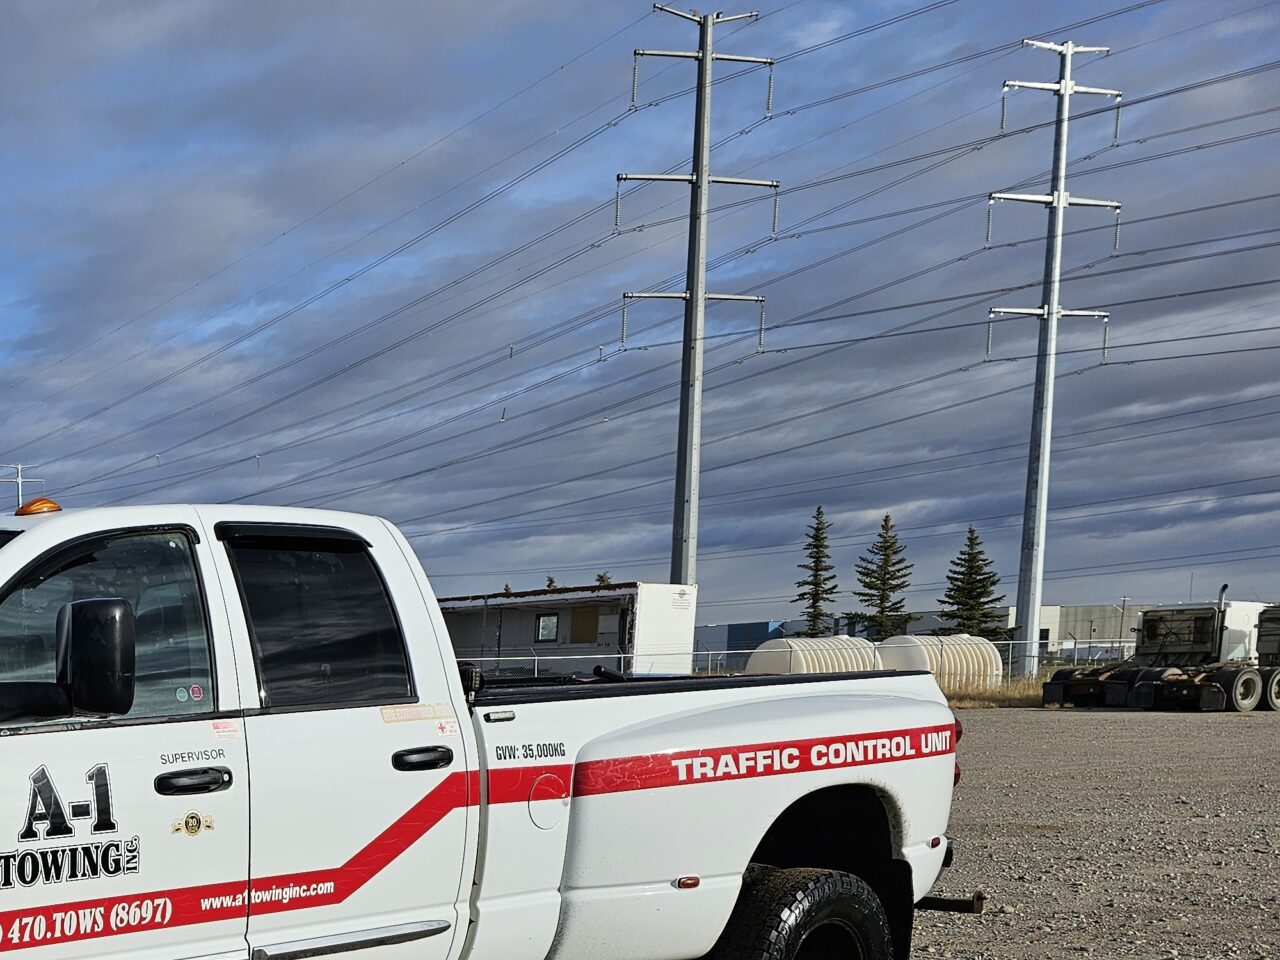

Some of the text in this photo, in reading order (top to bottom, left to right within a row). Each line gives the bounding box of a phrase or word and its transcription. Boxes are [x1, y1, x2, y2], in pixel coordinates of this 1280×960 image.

[160, 748, 226, 765] SUPERVISOR
[495, 742, 566, 761] GVW: 35,000KG
[672, 730, 951, 781] TRAFFIC CONTROL UNIT
[18, 763, 118, 842] A-1
[124, 835, 140, 875] INC.
[200, 881, 335, 905] www.a1towinginc.com
[8, 906, 104, 945] 470.TOWS
[110, 897, 172, 931] (8697)
